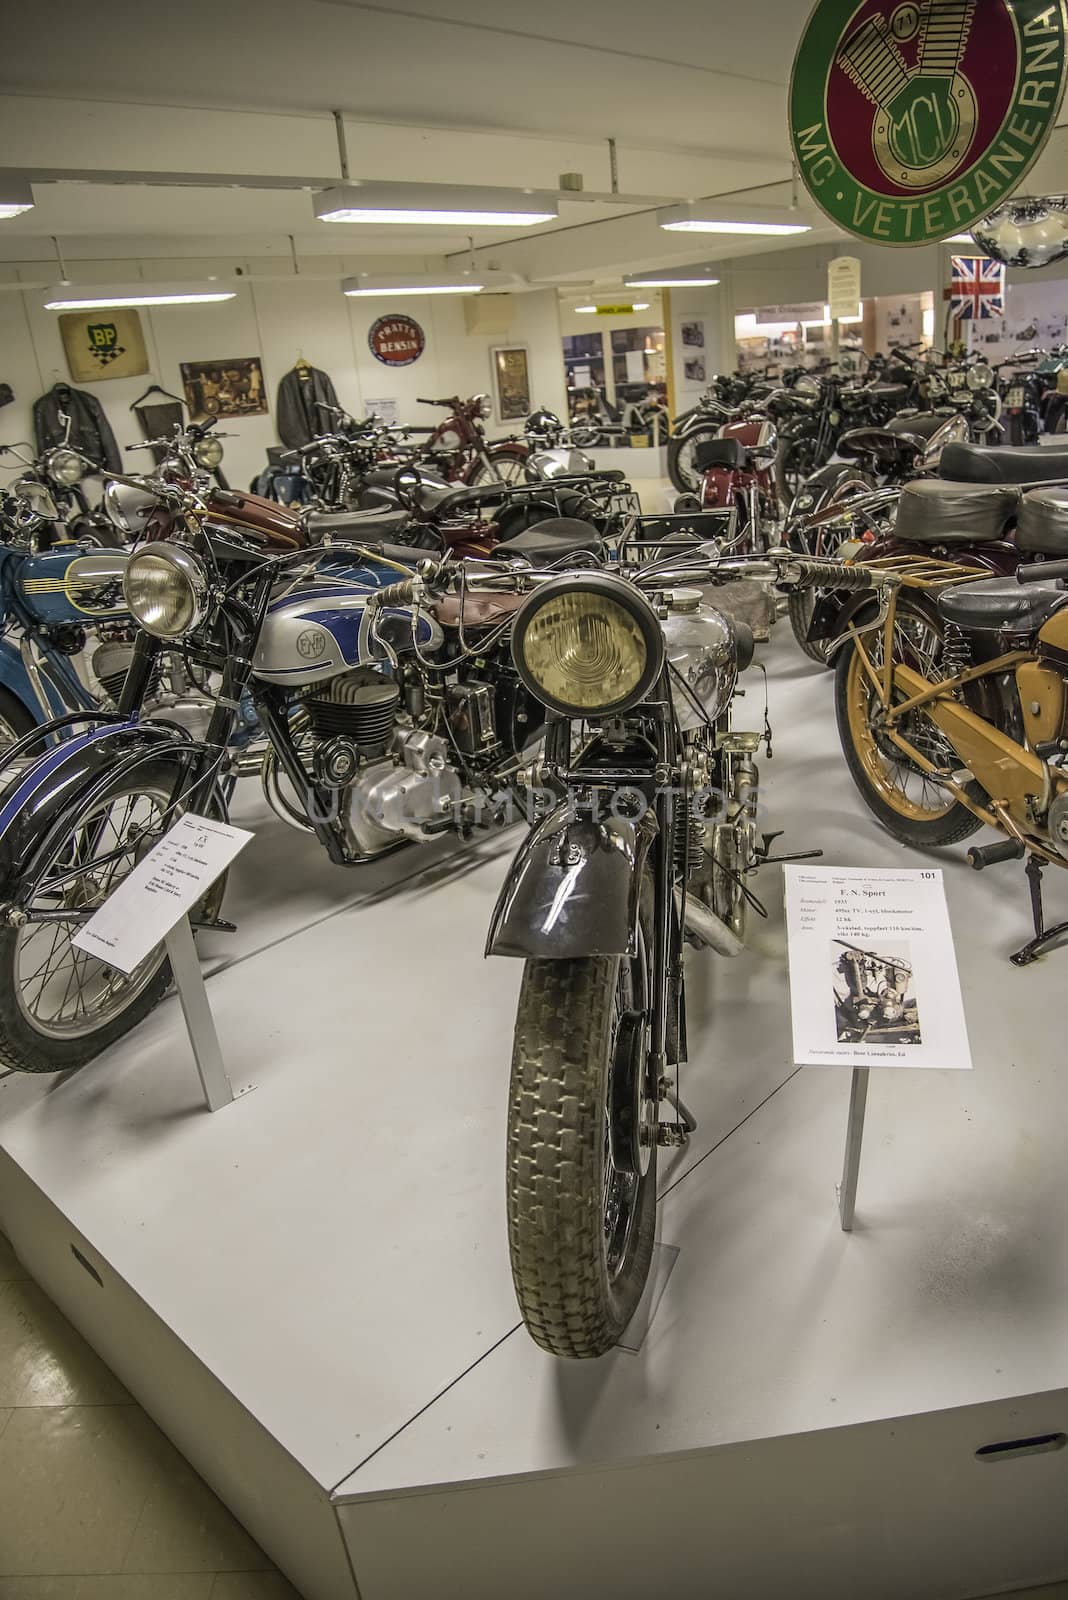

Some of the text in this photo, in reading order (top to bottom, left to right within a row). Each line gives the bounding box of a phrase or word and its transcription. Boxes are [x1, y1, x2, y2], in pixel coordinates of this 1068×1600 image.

[797, 5, 1059, 237] MC VETERANERNA
[93, 328, 115, 346] BP
[379, 340, 418, 353] BENSIN
[606, 496, 637, 511] TK
[920, 872, 936, 880] 101
[840, 889, 887, 898] F. N. Sport
